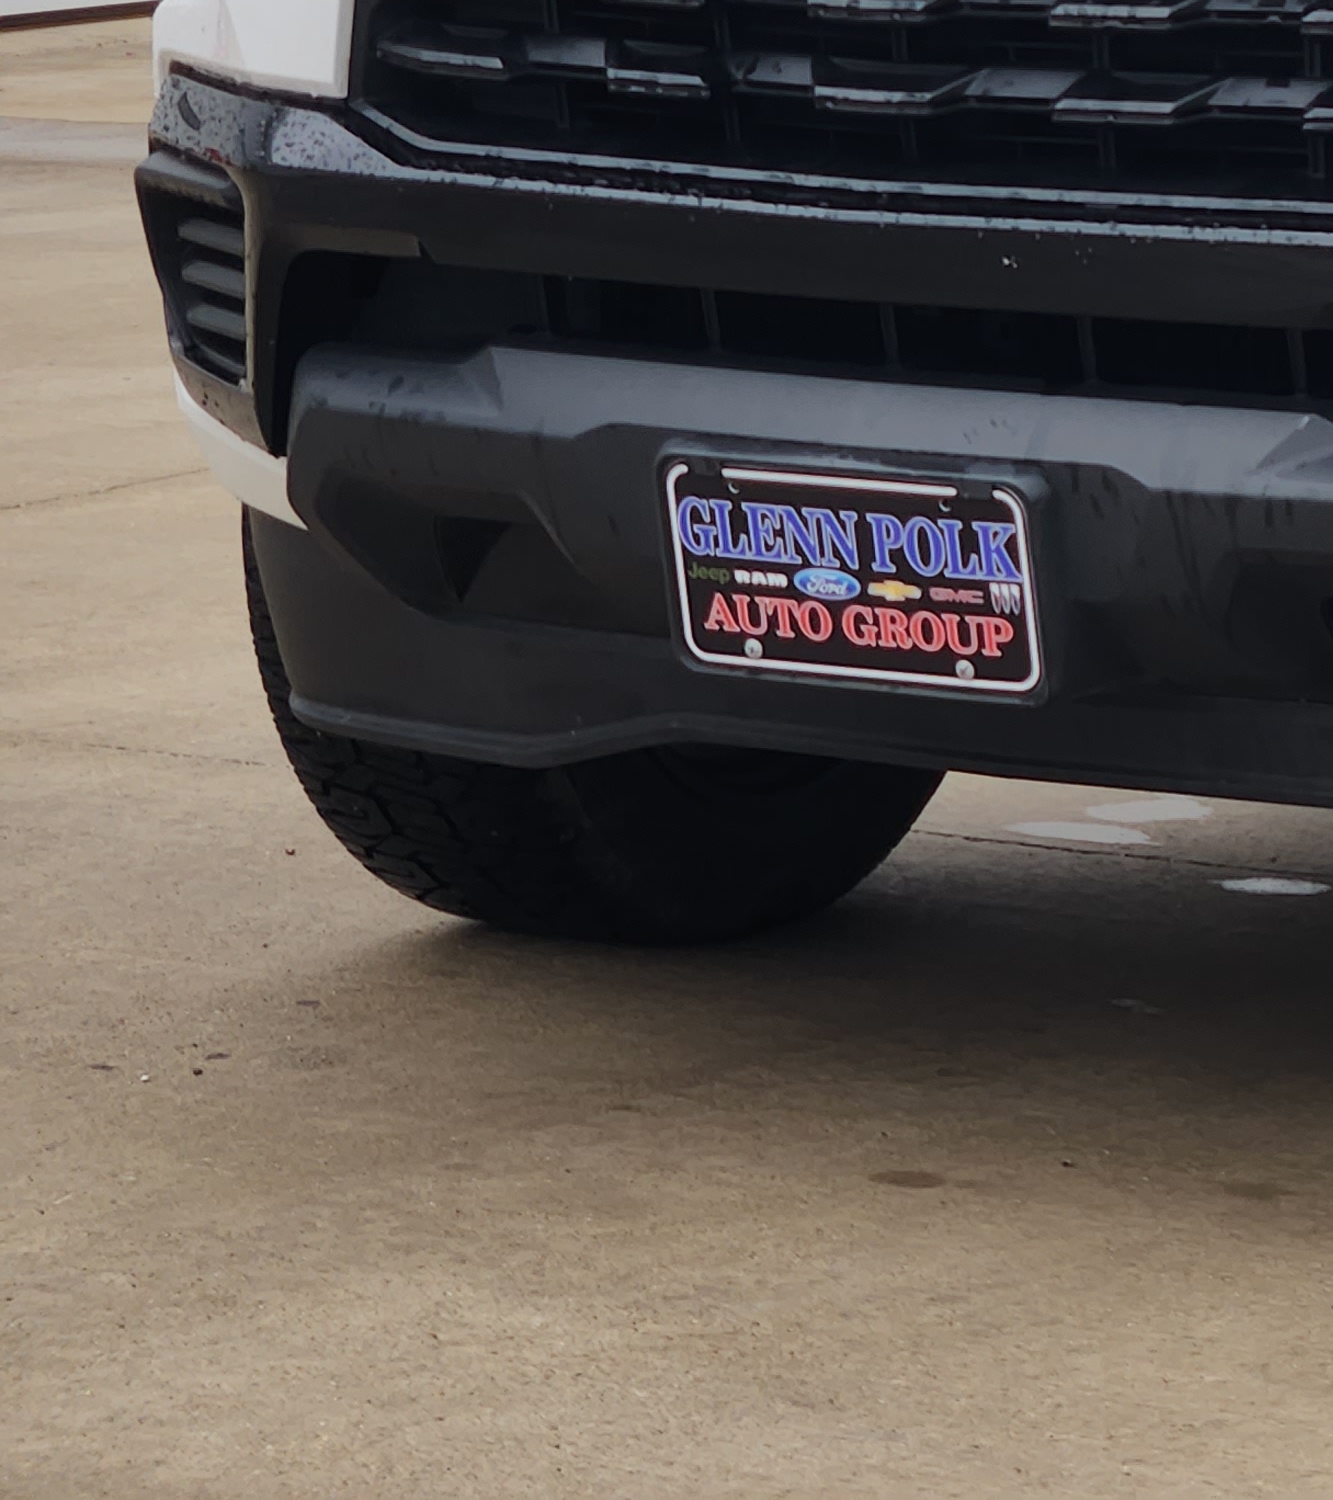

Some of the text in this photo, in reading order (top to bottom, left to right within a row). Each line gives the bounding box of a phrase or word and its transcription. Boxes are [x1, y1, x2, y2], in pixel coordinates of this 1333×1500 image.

[678, 495, 1023, 584] GLENN POLK
[688, 562, 985, 604] Jeep RAM Ford GMC
[704, 592, 1014, 657] AUTO GROUP
